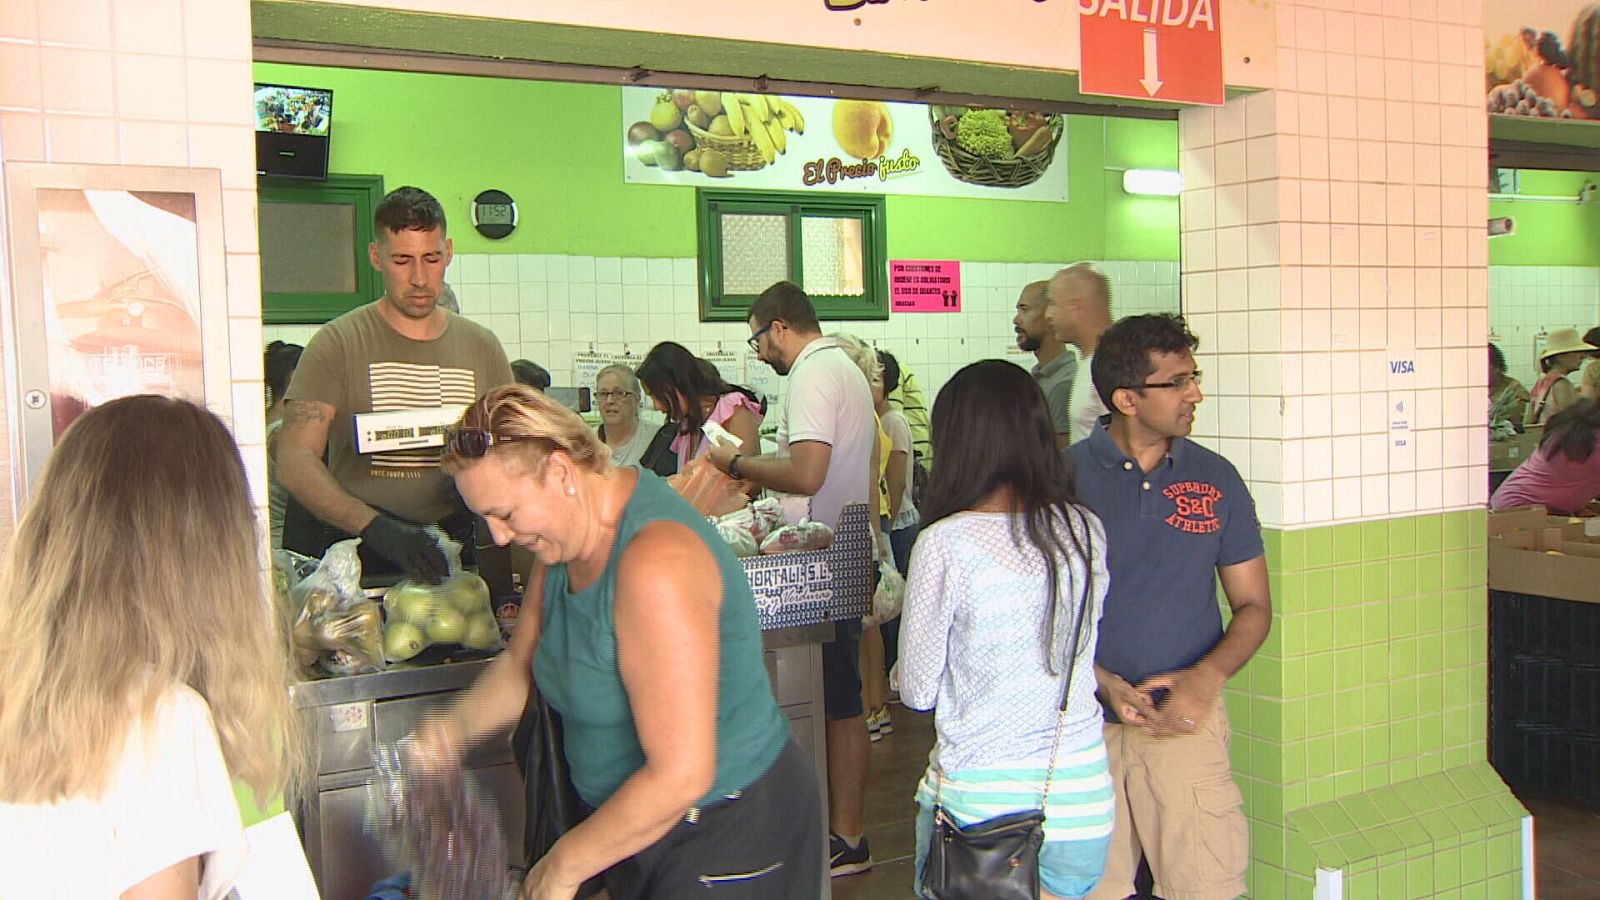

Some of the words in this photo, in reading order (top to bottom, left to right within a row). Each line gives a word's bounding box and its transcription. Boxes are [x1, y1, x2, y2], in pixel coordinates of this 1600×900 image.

[803, 158, 825, 186] El
[826, 157, 878, 185] Precio
[879, 148, 921, 182] justo
[1390, 361, 1415, 374] VISA
[1162, 481, 1223, 501] SUPERDRY
